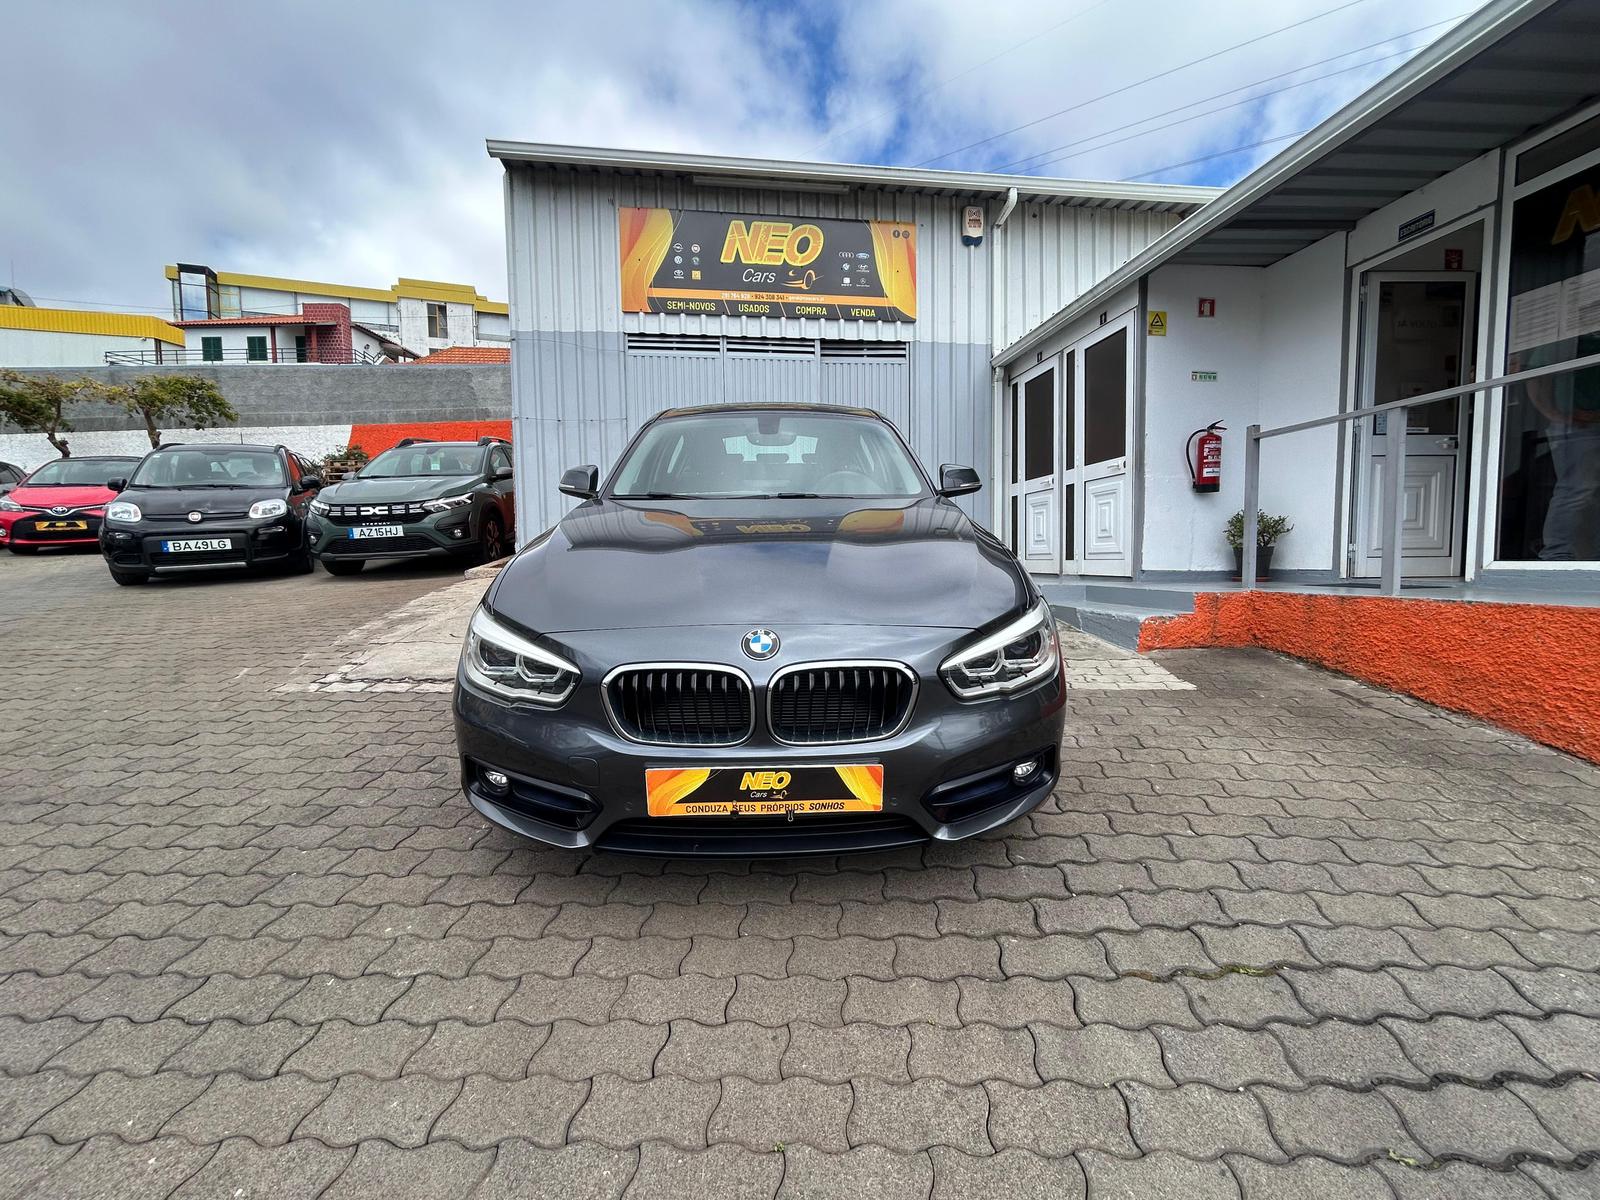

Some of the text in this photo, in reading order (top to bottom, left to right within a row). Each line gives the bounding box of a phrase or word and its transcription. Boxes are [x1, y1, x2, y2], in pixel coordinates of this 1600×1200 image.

[720, 220, 824, 267] NEO
[742, 268, 777, 283] Cars
[667, 301, 716, 311] SEMI-NOVOS
[738, 303, 770, 314] USADOS
[795, 305, 828, 316] COMPRA
[850, 308, 876, 318] VENDA
[359, 527, 398, 537] AZ15HJ
[172, 540, 227, 551] BA49LG
[739, 771, 792, 790] NEO
[685, 801, 845, 814] CONDUZA SEUS PRÓPRIOS SONHOS
